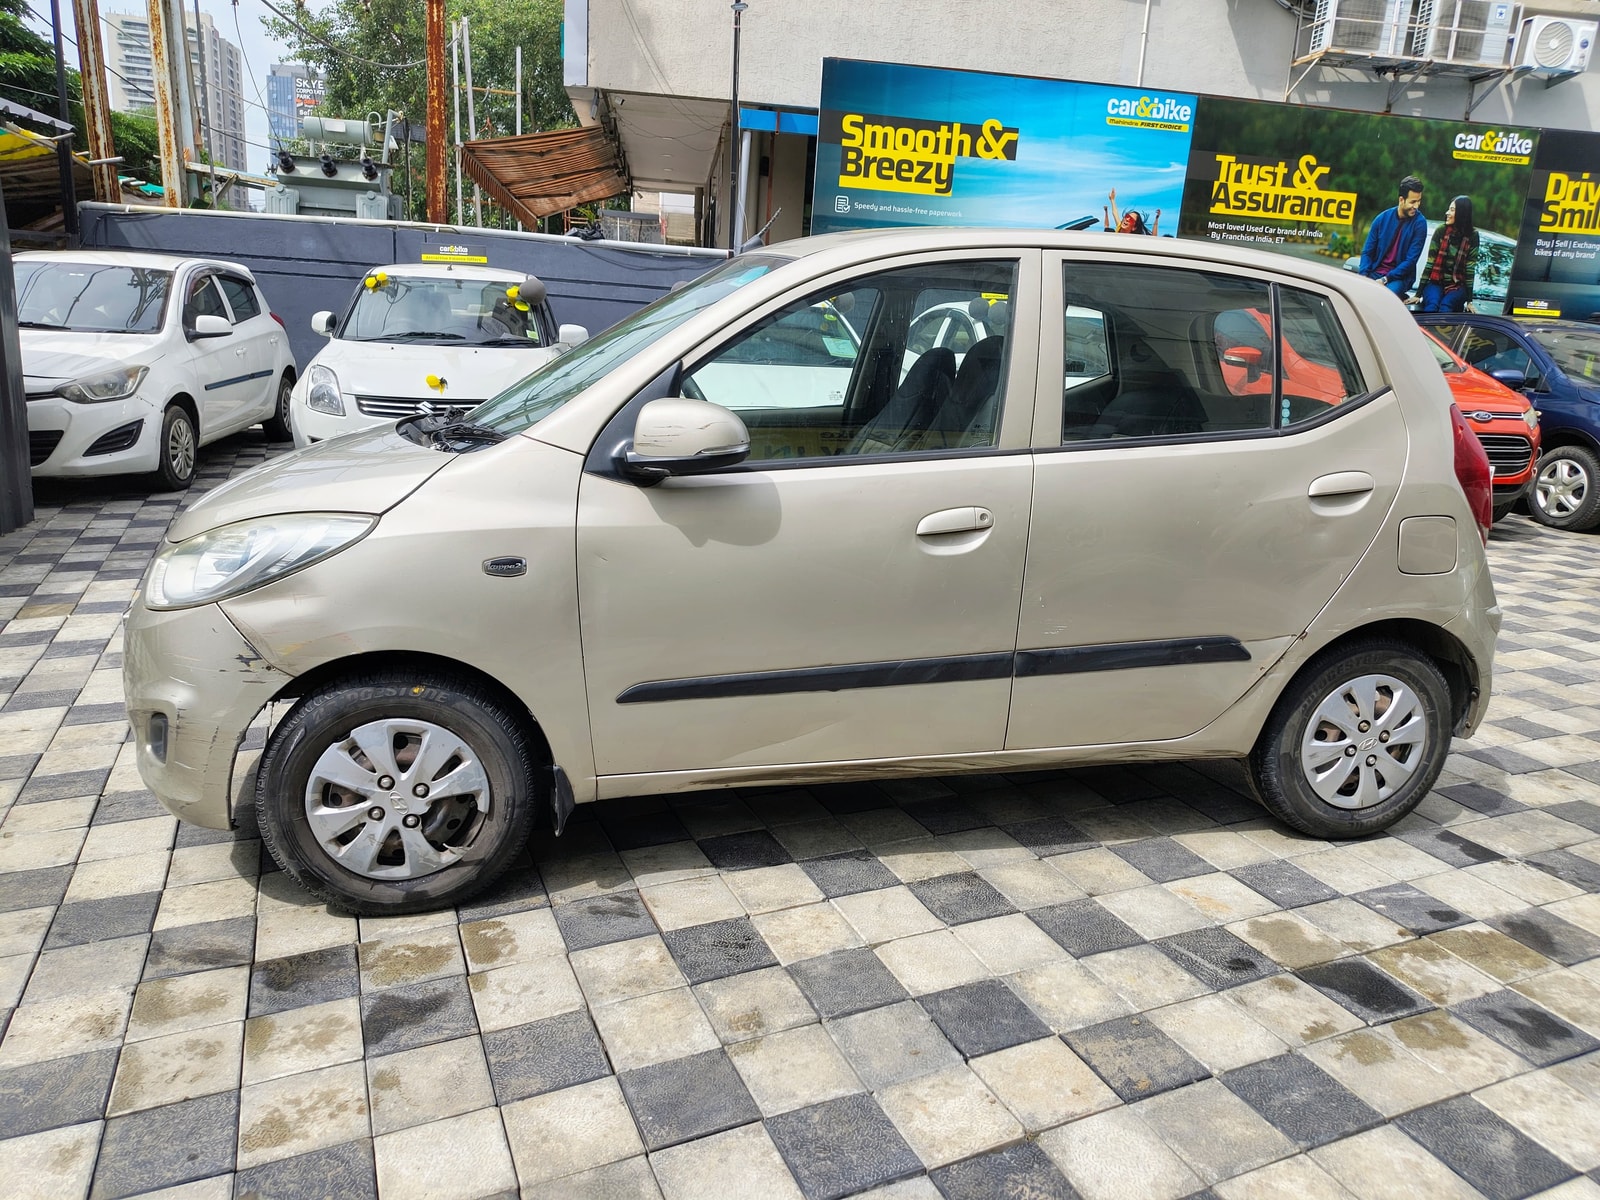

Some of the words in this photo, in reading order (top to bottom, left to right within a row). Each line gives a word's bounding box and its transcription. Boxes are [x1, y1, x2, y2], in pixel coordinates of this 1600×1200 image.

[296, 78, 324, 90] SKYE
[1107, 96, 1192, 122] car&bike
[1140, 121, 1159, 129] FIRST
[1159, 122, 1183, 131] CHOICE
[841, 113, 972, 157] Smooth
[975, 118, 1020, 161] &
[1454, 130, 1533, 155] car&bike
[840, 146, 956, 195] Breezy
[1215, 154, 1289, 188] Trust
[1292, 154, 1331, 191] &
[854, 202, 878, 212] Speedy
[879, 203, 892, 212] and
[893, 204, 928, 215] hassle-free
[929, 209, 963, 218] paperwork
[1210, 182, 1353, 220] Assurance
[1540, 200, 1600, 230] Smil
[1207, 221, 1226, 230] Most
[1226, 222, 1246, 231] loved
[1246, 225, 1264, 234] Used
[1264, 226, 1277, 234] Car
[1276, 228, 1297, 236] brand
[1297, 229, 1306, 237] of
[1306, 230, 1323, 238] India
[1210, 231, 1221, 240] By
[1221, 232, 1255, 242] Franchise
[1255, 235, 1274, 244] India,
[1275, 236, 1285, 244] ET
[1536, 238, 1551, 248] Buy
[1555, 240, 1568, 248] Sell
[1534, 248, 1552, 257] bikes
[1553, 249, 1561, 257] of
[1561, 250, 1575, 260] any
[1575, 250, 1596, 259] brand
